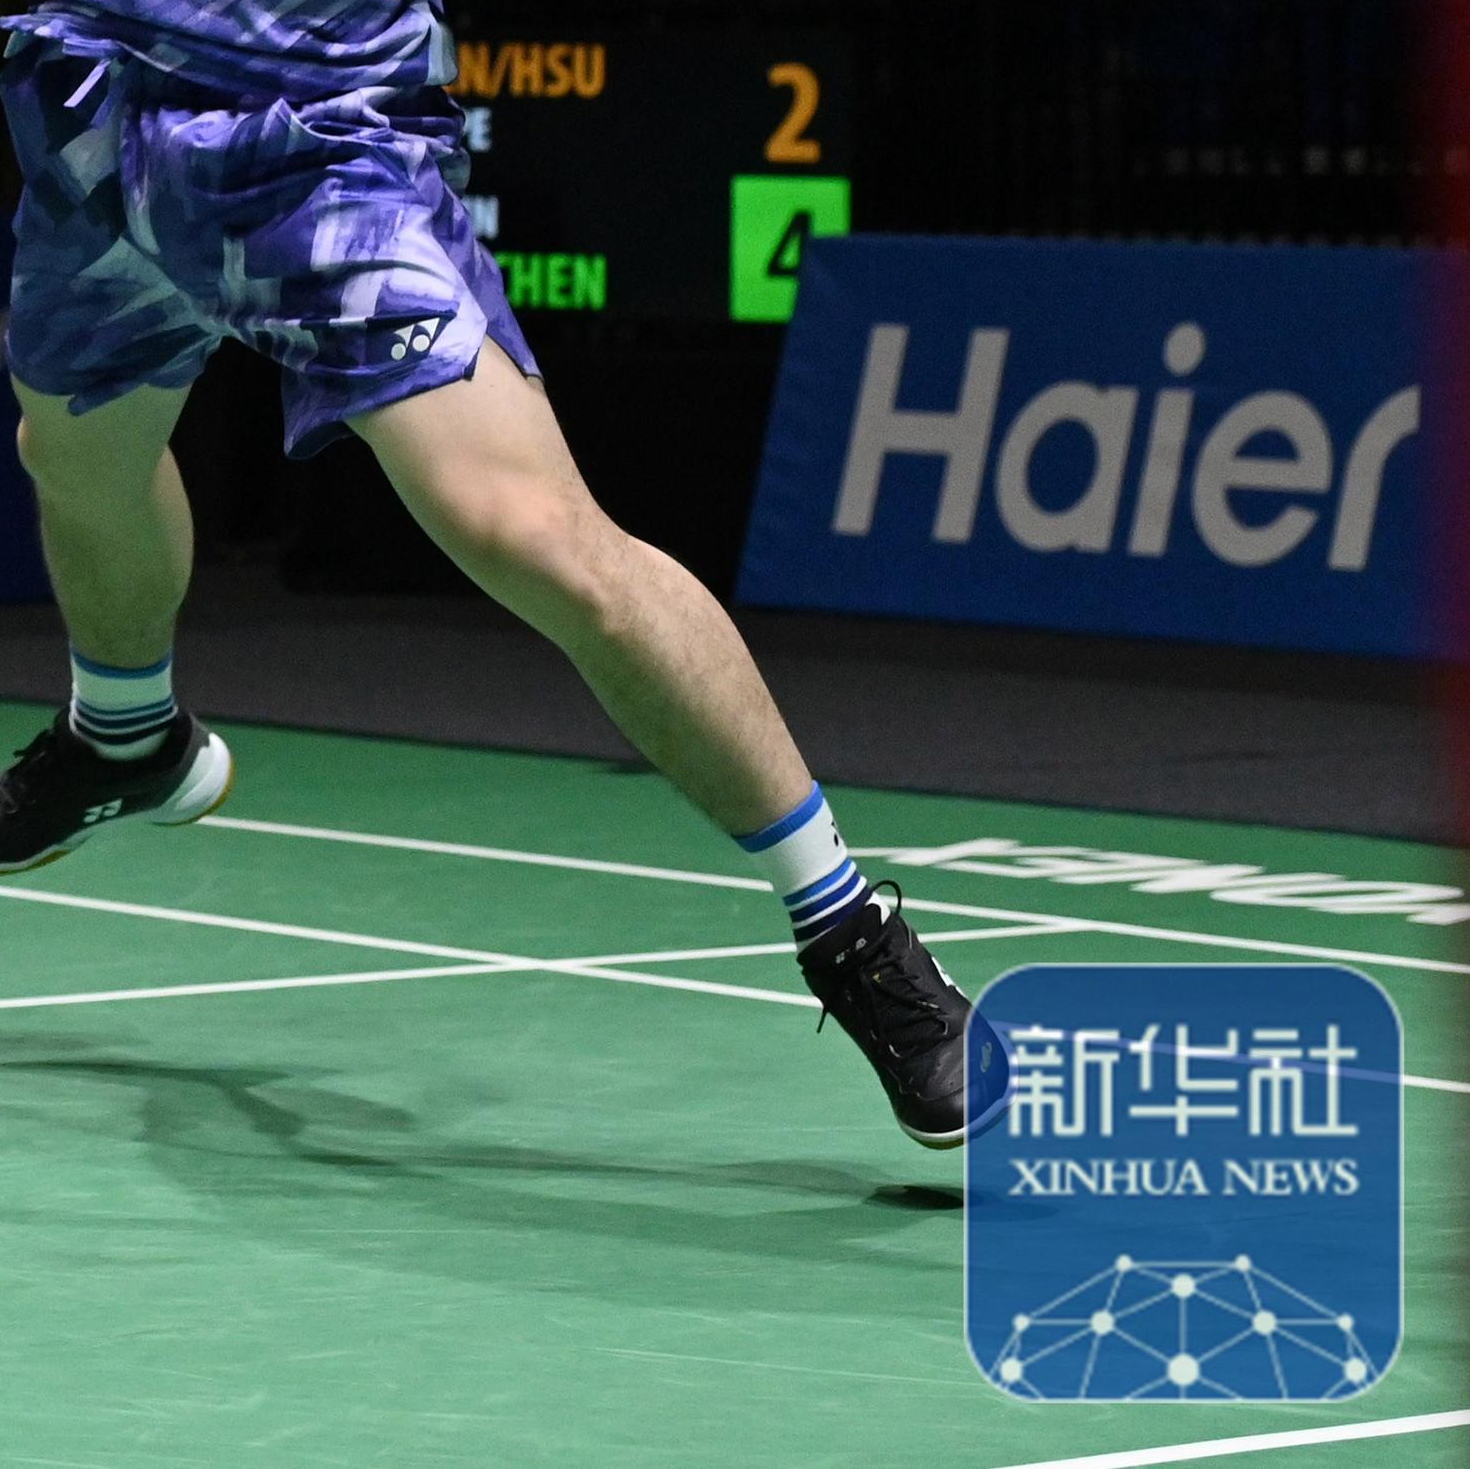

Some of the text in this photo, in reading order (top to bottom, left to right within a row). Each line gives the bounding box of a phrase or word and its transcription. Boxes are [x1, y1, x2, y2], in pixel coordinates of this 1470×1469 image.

[445, 41, 607, 98] N/HSU
[765, 62, 821, 163] 2
[832, 323, 1422, 572] Haier
